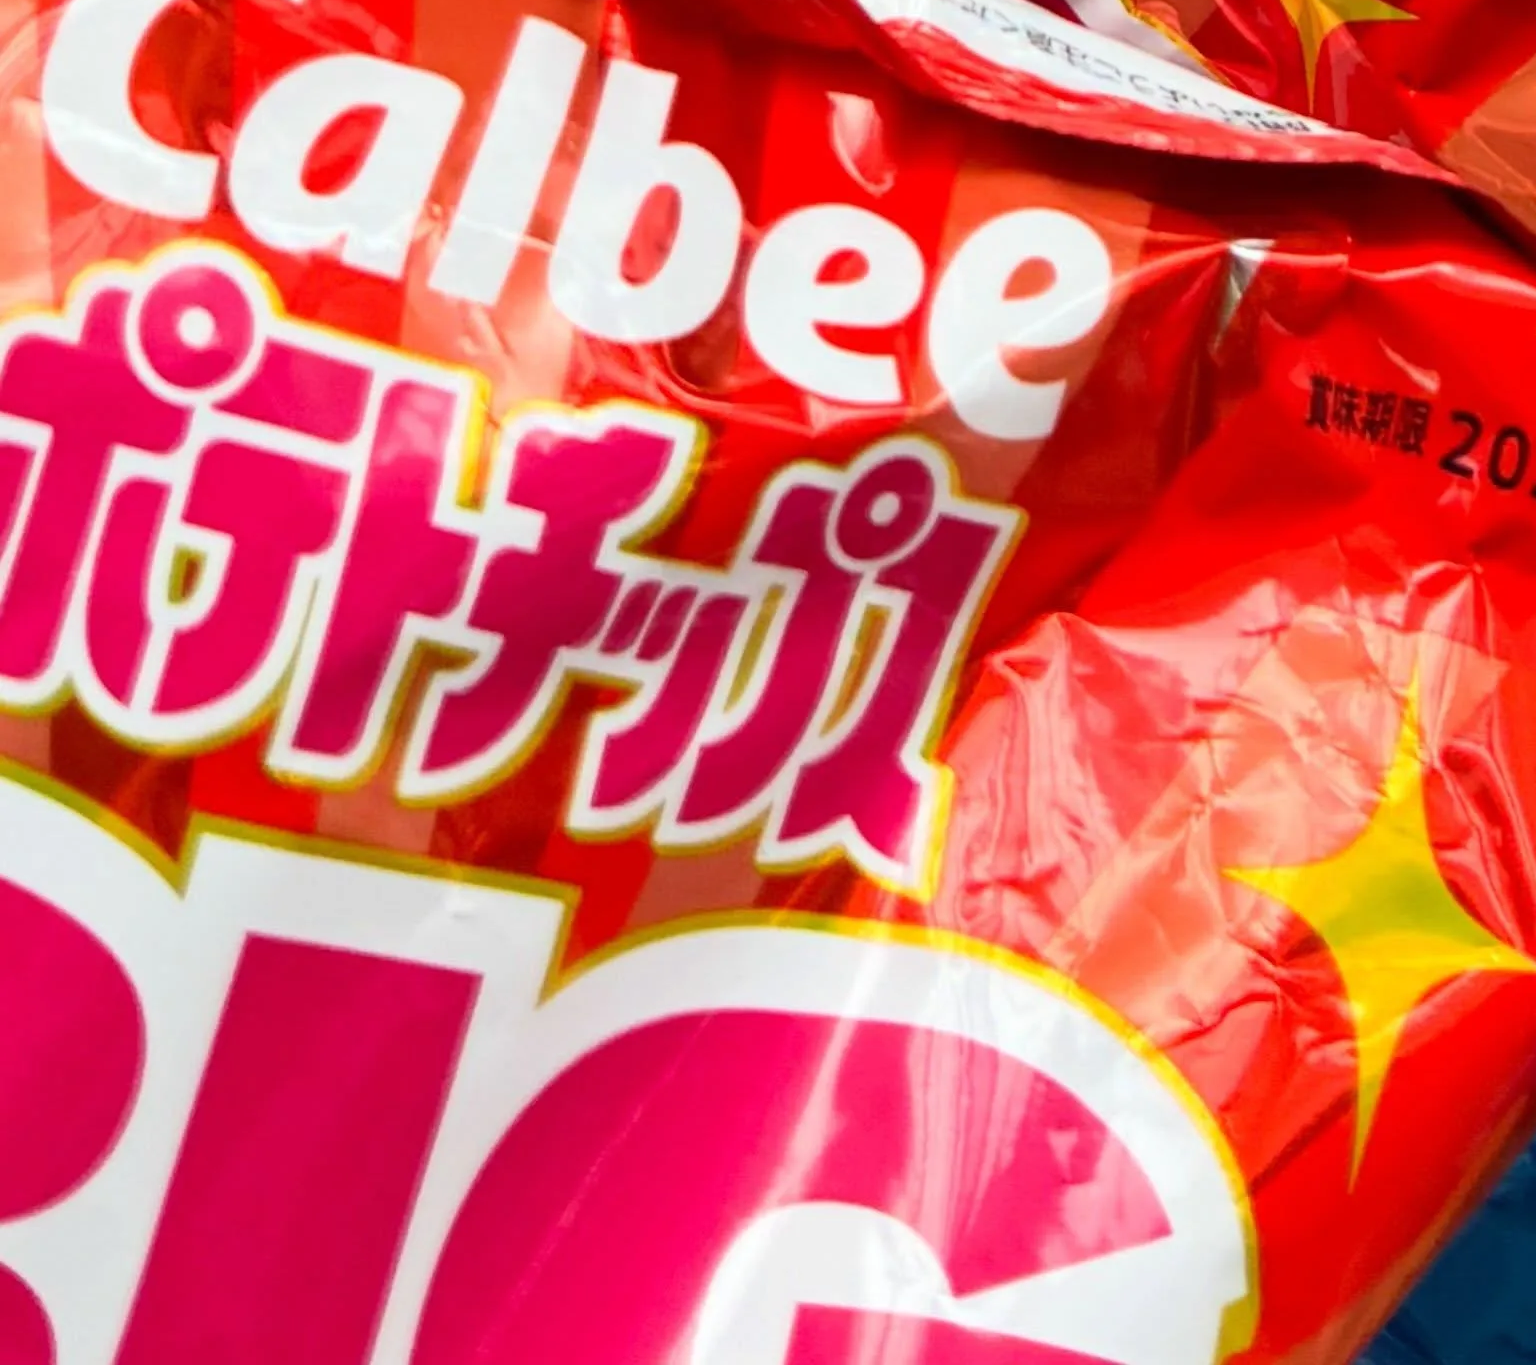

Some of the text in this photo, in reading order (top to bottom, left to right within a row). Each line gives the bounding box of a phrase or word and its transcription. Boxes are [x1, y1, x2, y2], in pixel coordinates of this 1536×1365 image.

[0, 243, 1026, 896] ポテトチップス
[1303, 371, 1433, 458] 賞味期限
